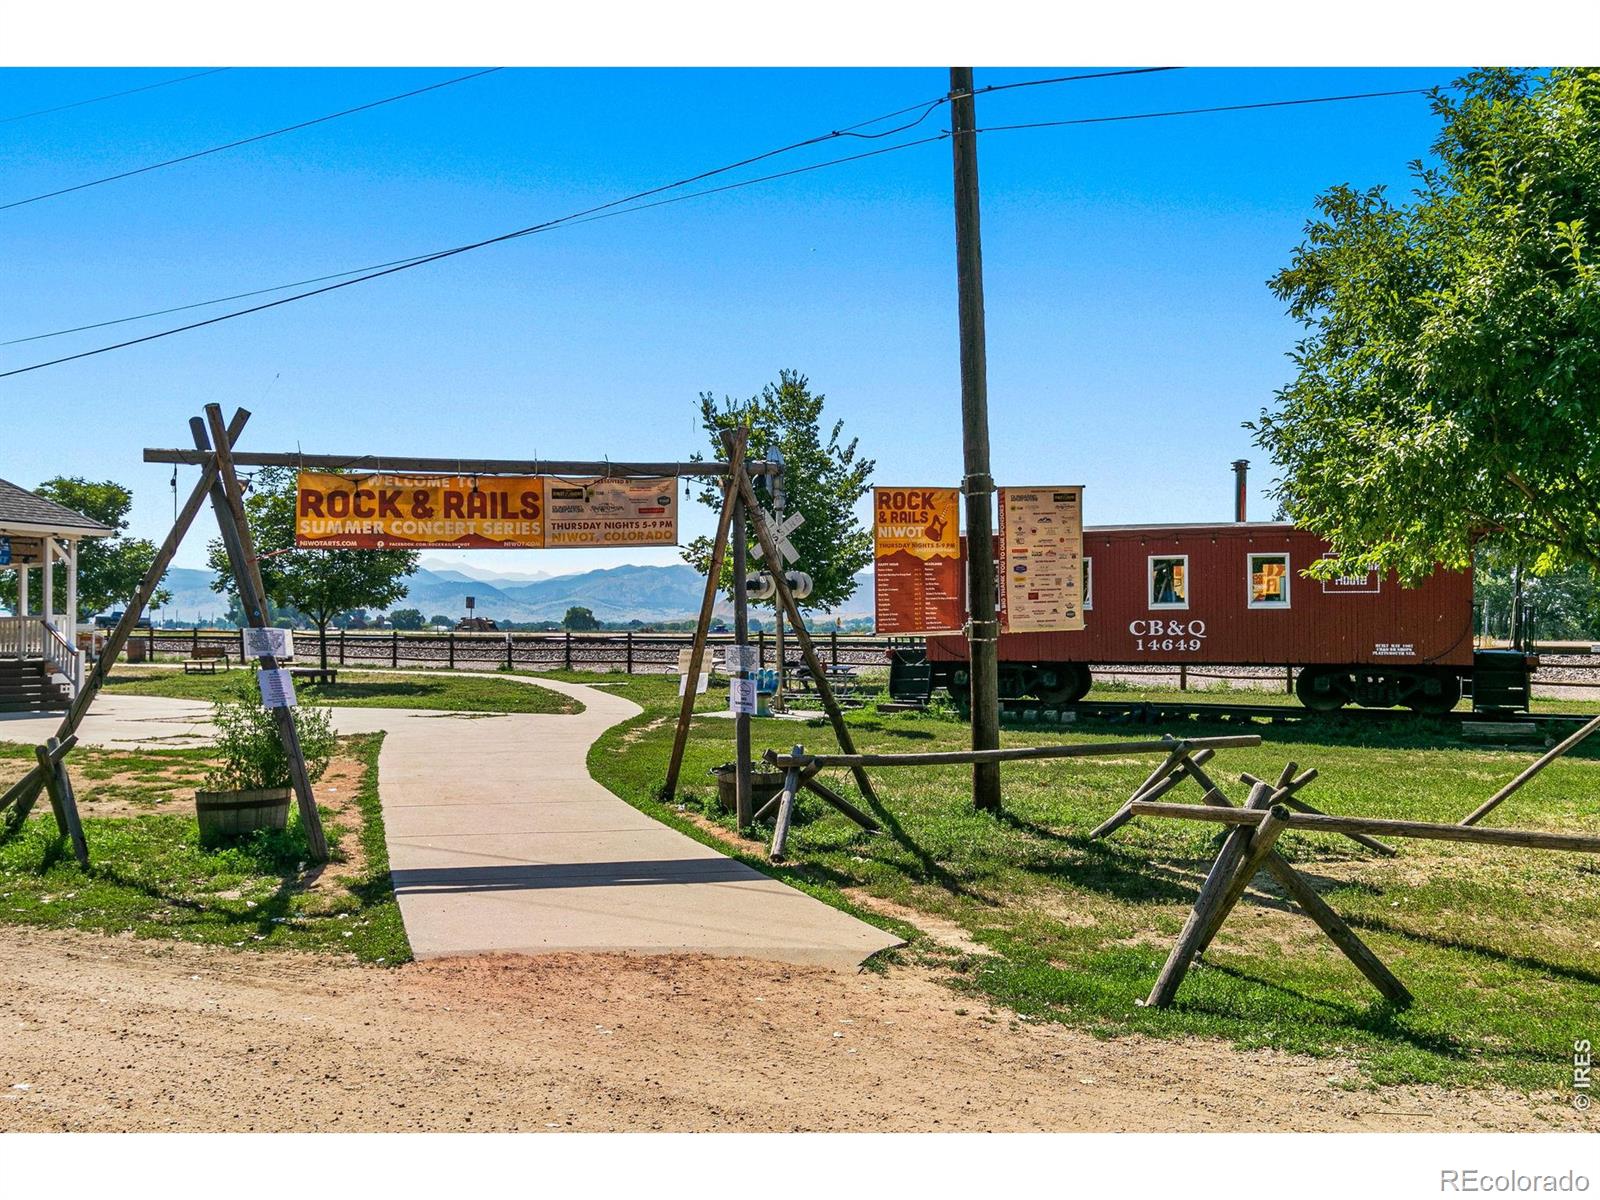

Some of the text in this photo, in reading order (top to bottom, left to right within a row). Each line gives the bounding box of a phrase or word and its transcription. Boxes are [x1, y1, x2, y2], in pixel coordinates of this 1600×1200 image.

[368, 475, 480, 488] WELCOME TO
[300, 489, 541, 520] ROCK & RAILS
[877, 491, 936, 511] ROCK
[878, 510, 929, 524] & RAILS
[300, 520, 541, 536] SUMMER CONCERT SERIES
[551, 520, 673, 531] THURSDAY NIGHTS 5-9 PM
[878, 526, 925, 538] NIWOT
[551, 530, 673, 544] NIWOT, COLORADO
[299, 540, 358, 548] NIWOTARTS.COM
[1000, 552, 1006, 560] TO
[1129, 619, 1207, 638] CB&Q
[1136, 638, 1201, 651] 14649
